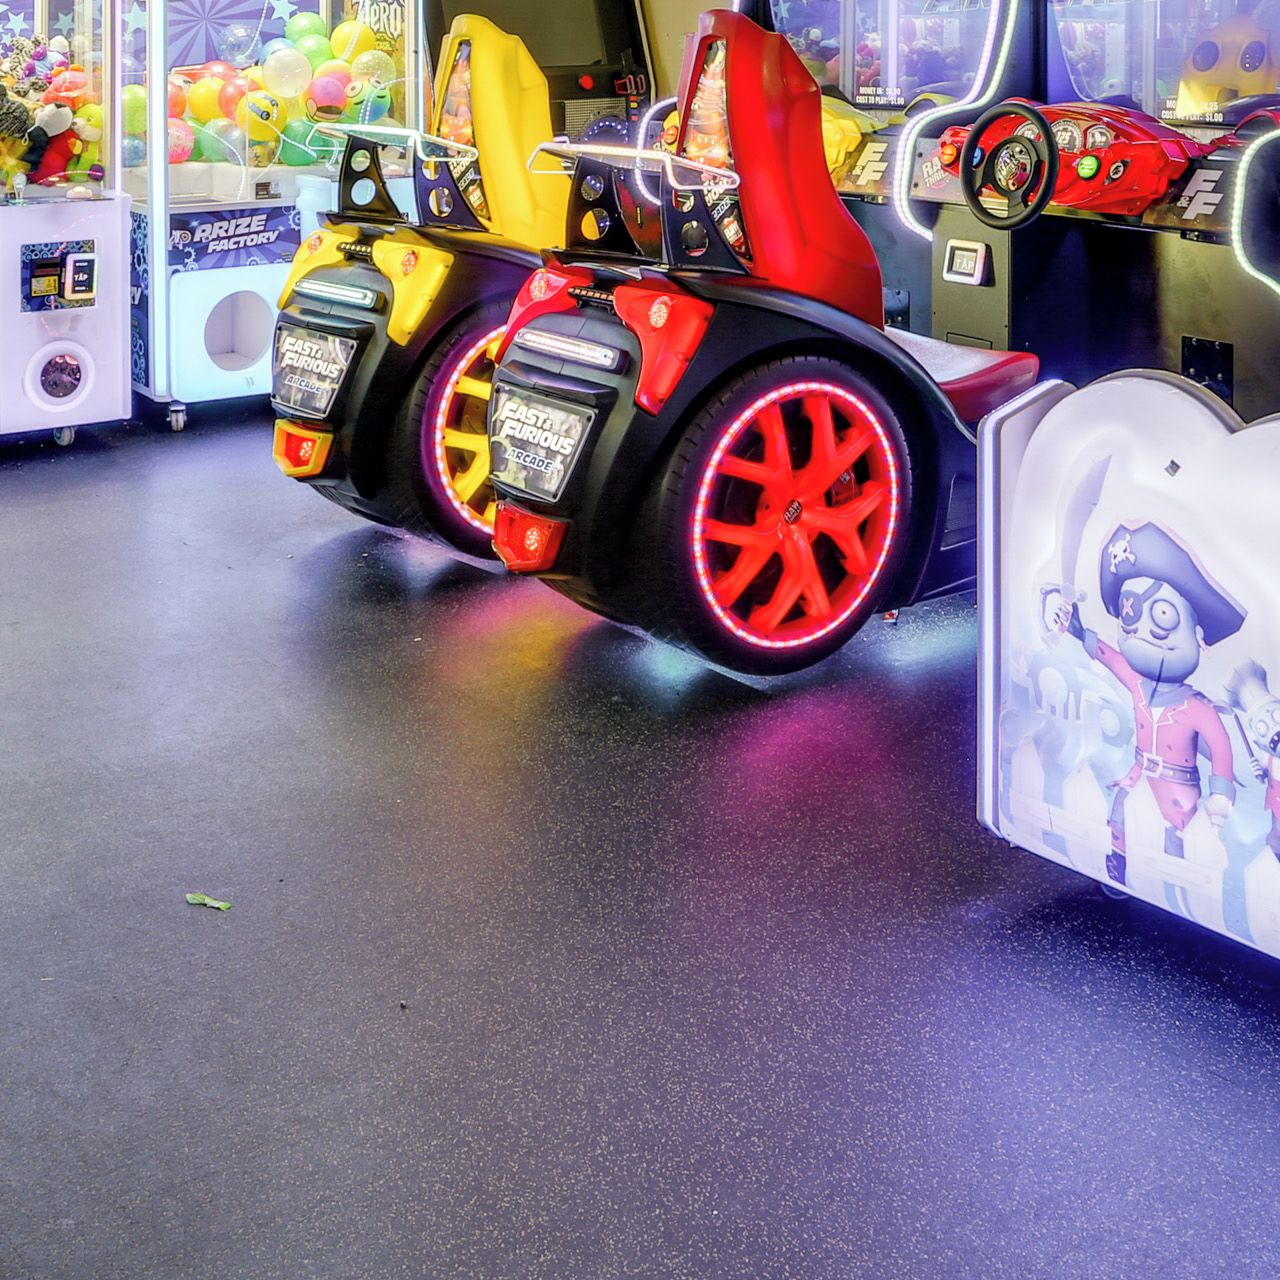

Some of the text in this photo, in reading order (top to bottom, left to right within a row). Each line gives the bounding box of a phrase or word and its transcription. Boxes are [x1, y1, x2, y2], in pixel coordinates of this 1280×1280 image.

[860, 87, 876, 95] MONEY
[875, 96, 889, 104] PLAY:
[890, 96, 905, 105] $1.00
[1205, 112, 1224, 122] $1.00
[856, 142, 889, 166] F
[856, 161, 889, 186] F
[921, 156, 941, 179] RA
[1182, 168, 1224, 197] F
[1176, 196, 1191, 208] &
[1182, 191, 1224, 220] F
[193, 213, 268, 243] PRIZE
[207, 229, 279, 253] FACTORY
[955, 259, 974, 271] TAP
[74, 273, 88, 282] TAP
[281, 336, 323, 358] FAST &
[281, 351, 341, 379] FURIOUS
[285, 374, 322, 393] ARCADE
[500, 400, 553, 431] FAST &
[500, 418, 576, 456] FURIOUS
[505, 447, 554, 474] ARCADE
